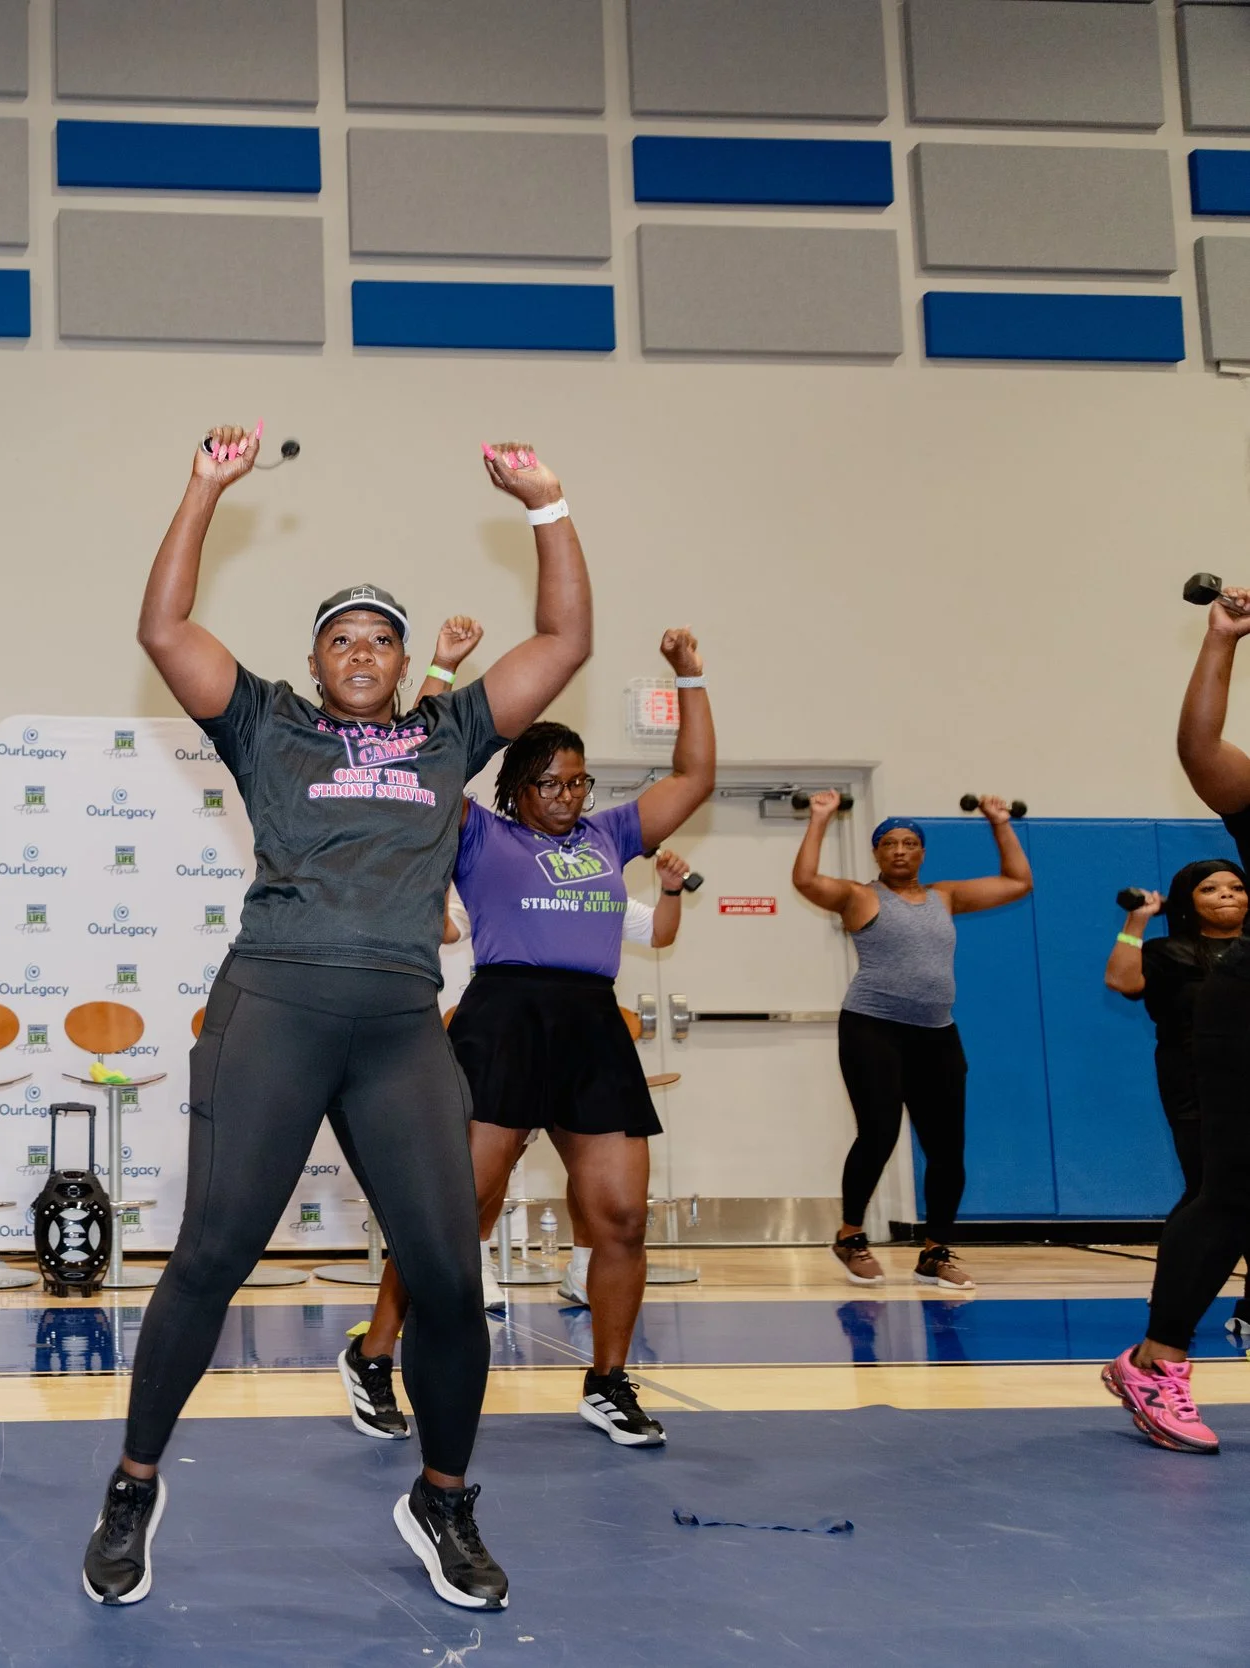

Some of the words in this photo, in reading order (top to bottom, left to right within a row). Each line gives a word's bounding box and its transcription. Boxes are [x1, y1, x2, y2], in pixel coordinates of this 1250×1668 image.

[116, 739, 133, 748] LIFE
[175, 749, 222, 763] OurLeg
[334, 768, 382, 783] ONLY
[385, 769, 418, 787] THE
[27, 795, 44, 804] LIFE
[309, 783, 374, 798] STRONG
[376, 784, 436, 806] SURVIVE
[206, 798, 222, 806] LIFE
[86, 805, 156, 820] OurLegacy
[117, 855, 134, 863] LIFE
[176, 864, 245, 879] OurLegacy
[554, 860, 602, 880] CAMP
[556, 889, 584, 901] ONLY
[588, 891, 611, 902] THE
[521, 898, 579, 911] STRONG
[28, 914, 46, 922] LIFE
[207, 915, 223, 923] LIFE
[87, 922, 157, 937] OurLegacy
[118, 973, 135, 982] LIFE
[29, 1034, 46, 1043] LIFE
[0, 1103, 52, 1118] OurLeg
[30, 1155, 47, 1163] LIFE
[93, 1164, 161, 1178] Ouegacy
[303, 1165, 340, 1176] egacy
[302, 1212, 319, 1221] LIFE
